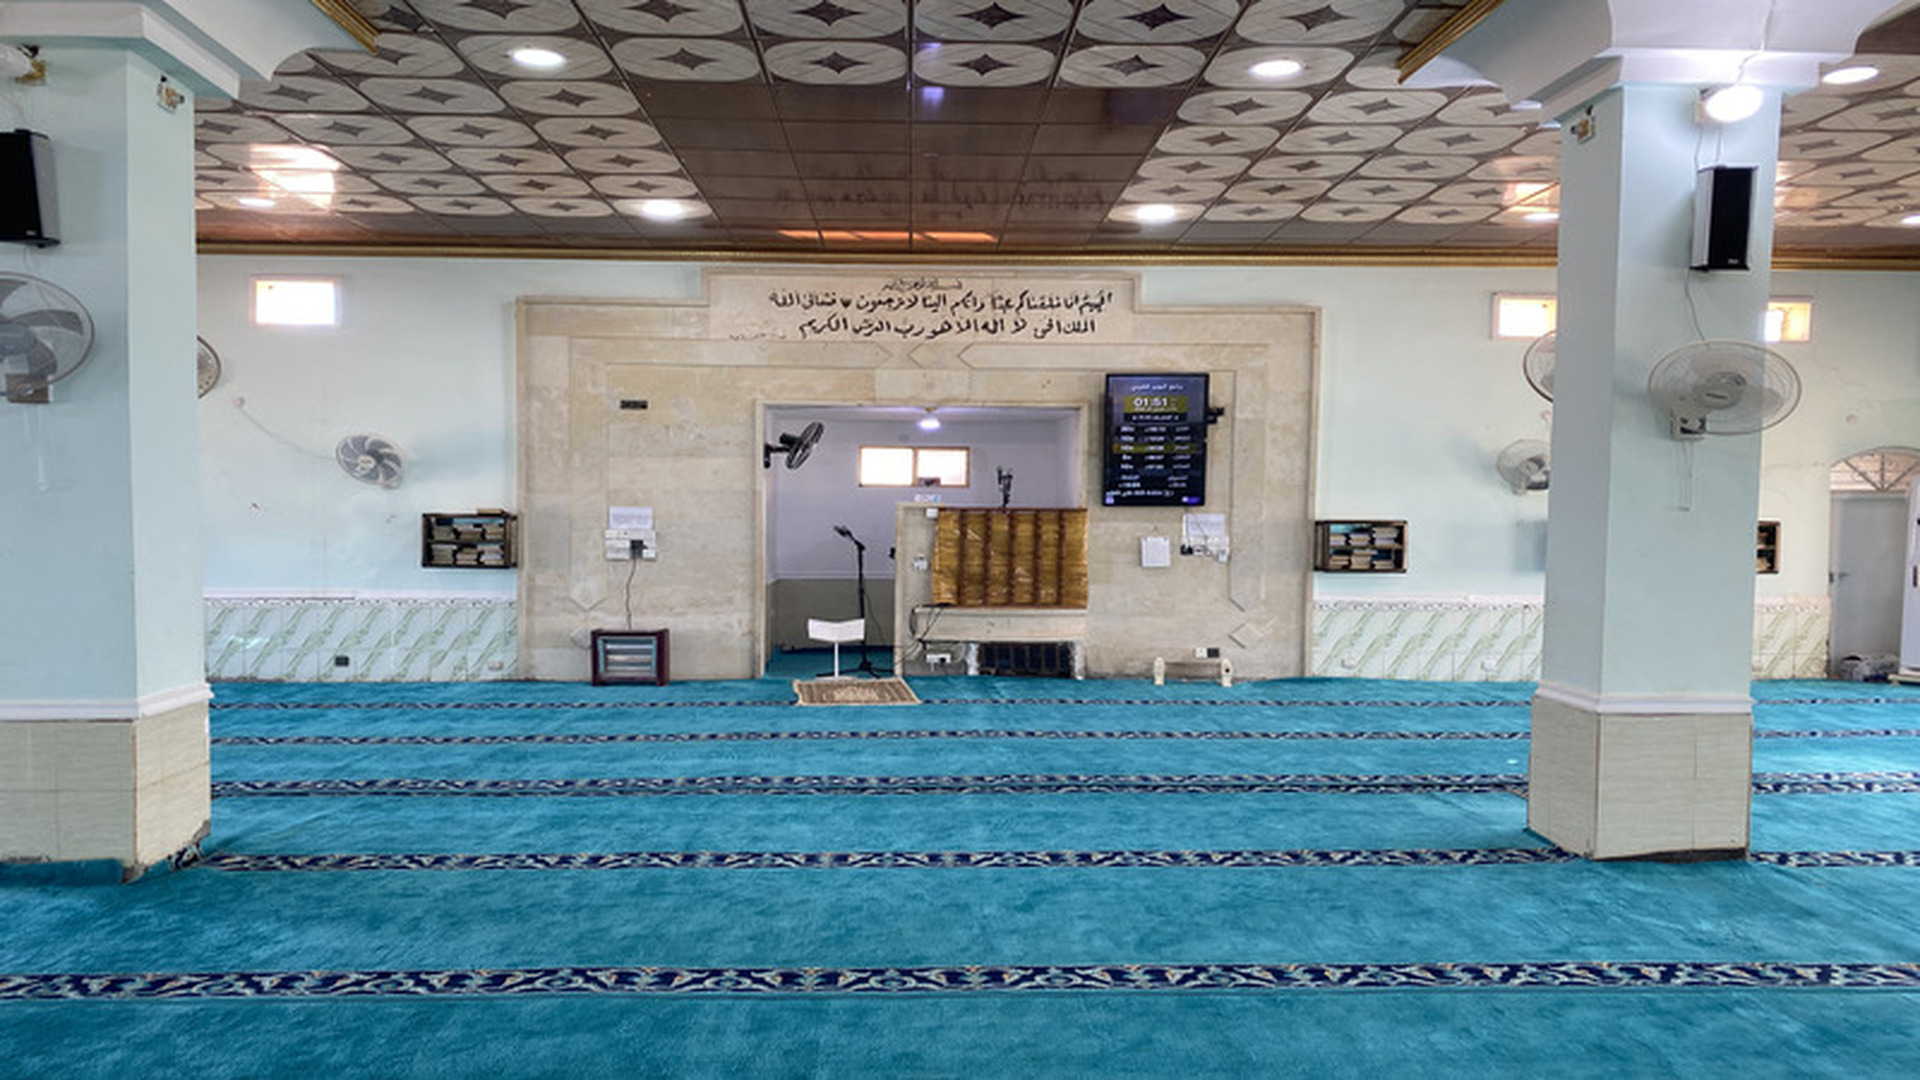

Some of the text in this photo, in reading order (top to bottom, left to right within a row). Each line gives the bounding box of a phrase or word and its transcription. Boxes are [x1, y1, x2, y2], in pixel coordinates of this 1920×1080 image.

[905, 294, 919, 310] لا
[798, 312, 849, 339] الكريم
[852, 319, 892, 337] العرش
[894, 324, 925, 339] رب
[926, 320, 953, 339] هو
[1010, 319, 1028, 334] لا
